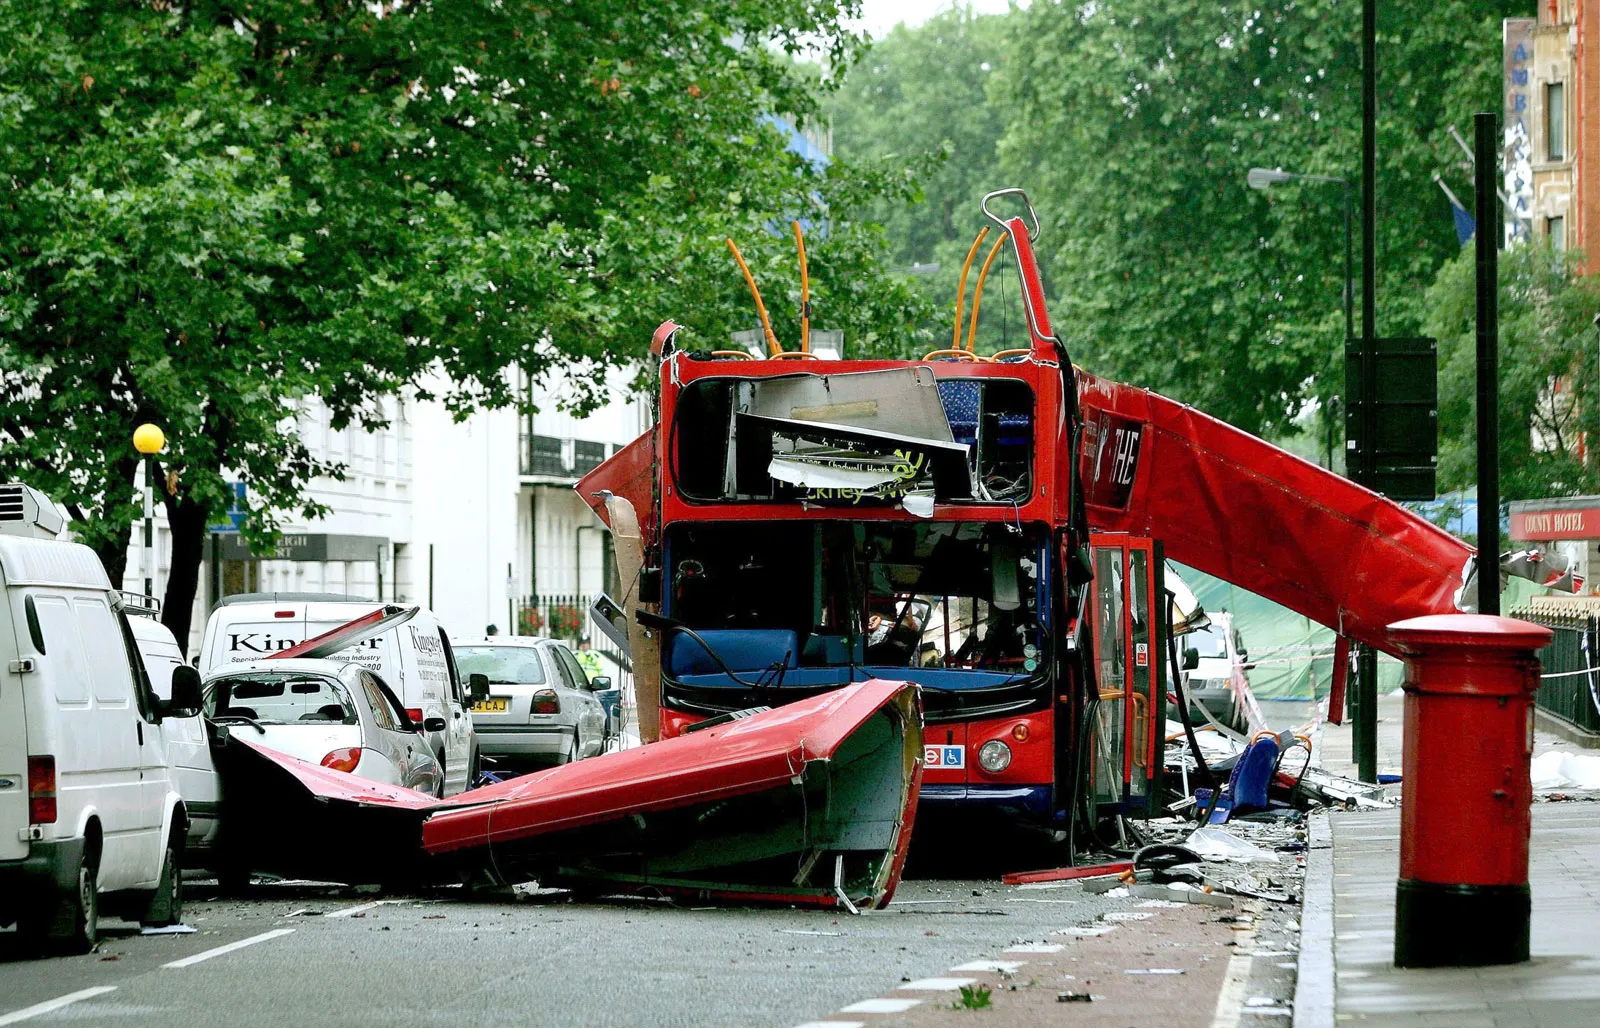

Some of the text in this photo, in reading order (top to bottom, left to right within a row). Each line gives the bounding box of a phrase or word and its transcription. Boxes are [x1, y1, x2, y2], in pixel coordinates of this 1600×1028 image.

[1109, 428, 1139, 485] THE
[1525, 513, 1584, 533] COUNTY HOTEL
[228, 633, 384, 653] Kinr
[485, 700, 506, 711] CAJ
